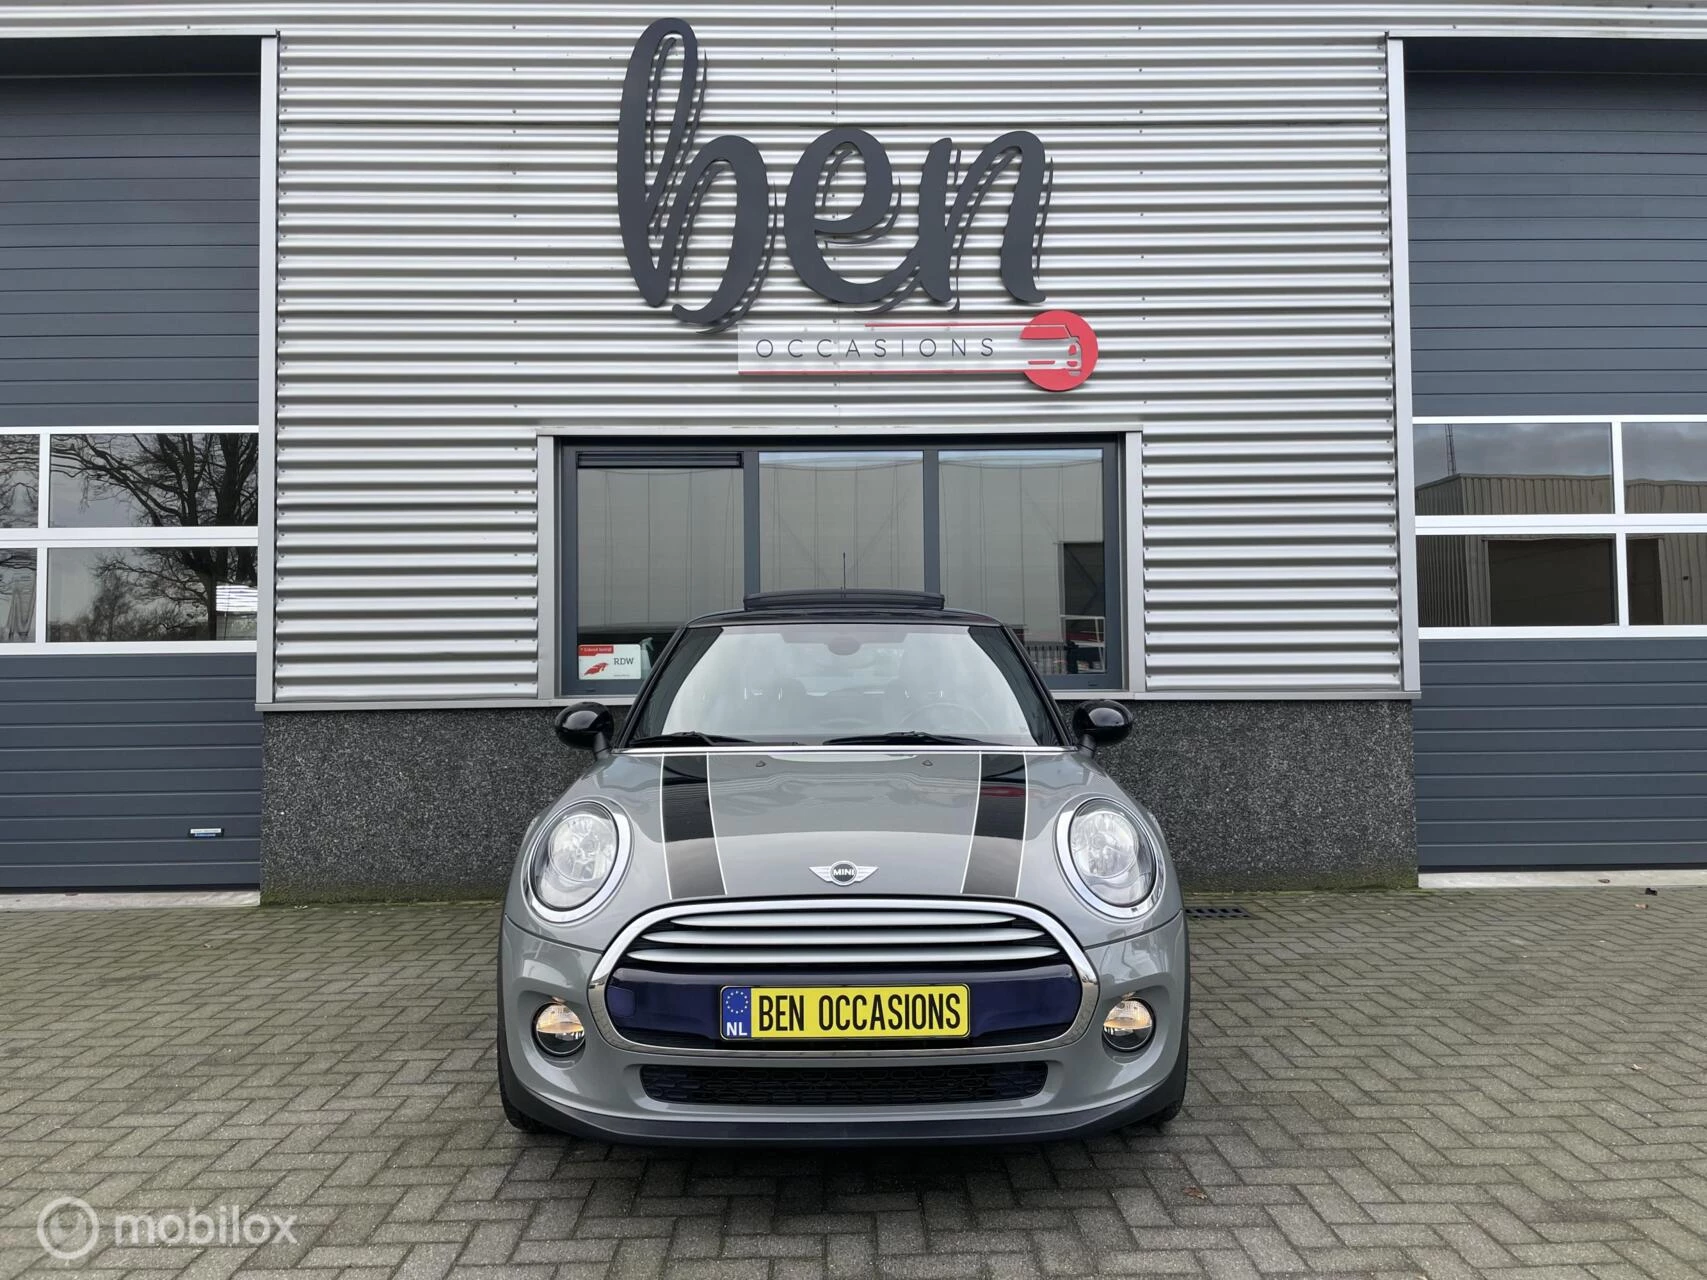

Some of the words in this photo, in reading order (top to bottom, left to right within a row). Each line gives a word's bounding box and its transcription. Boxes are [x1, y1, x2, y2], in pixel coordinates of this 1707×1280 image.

[617, 17, 1049, 325] ben
[755, 337, 995, 360] OCCASIONS
[613, 657, 634, 665] RDW
[759, 995, 804, 1031] BEN
[818, 993, 961, 1031] OCCASIONS
[726, 1022, 748, 1037] NL
